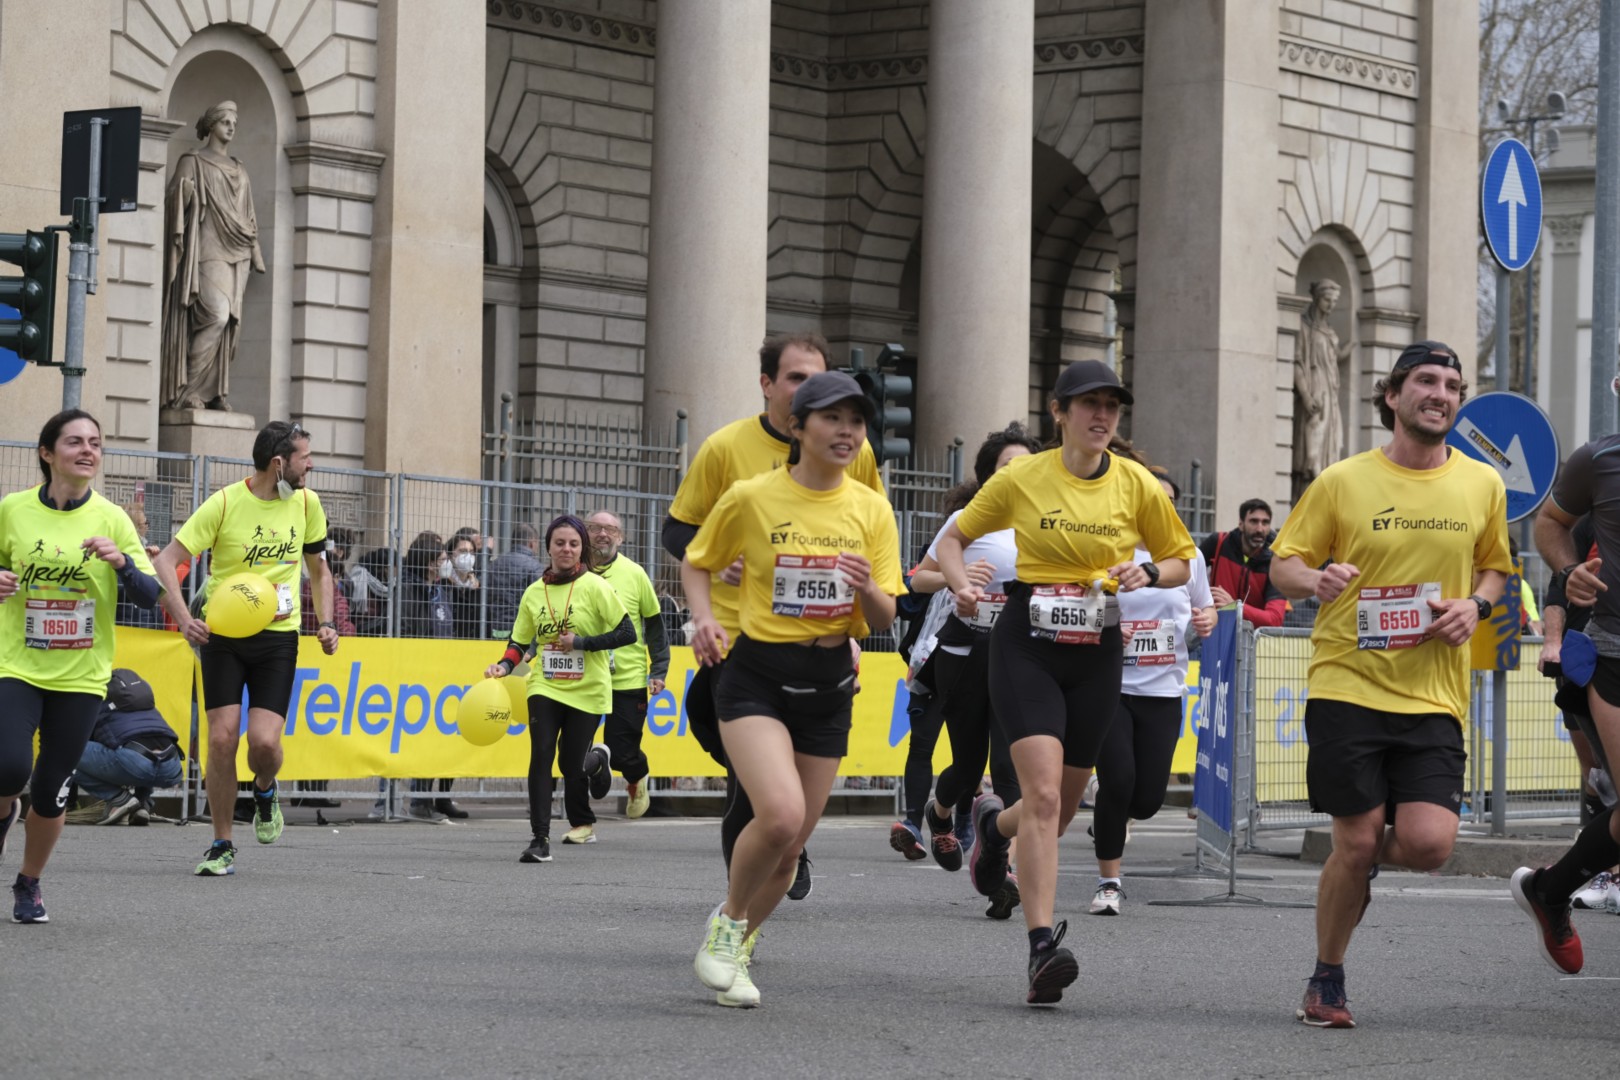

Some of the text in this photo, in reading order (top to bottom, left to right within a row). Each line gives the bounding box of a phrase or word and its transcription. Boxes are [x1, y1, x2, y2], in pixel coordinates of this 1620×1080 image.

[1040, 518, 1057, 530] EY
[1373, 517, 1468, 533] EY Foundation
[771, 532, 862, 549] EY Foundation
[797, 580, 837, 599] 655A
[42, 619, 78, 635] 1851D
[1379, 610, 1421, 631] 655D
[1134, 638, 1158, 652] 771A
[549, 657, 573, 670] 1851C
[284, 661, 530, 754] Telepa
